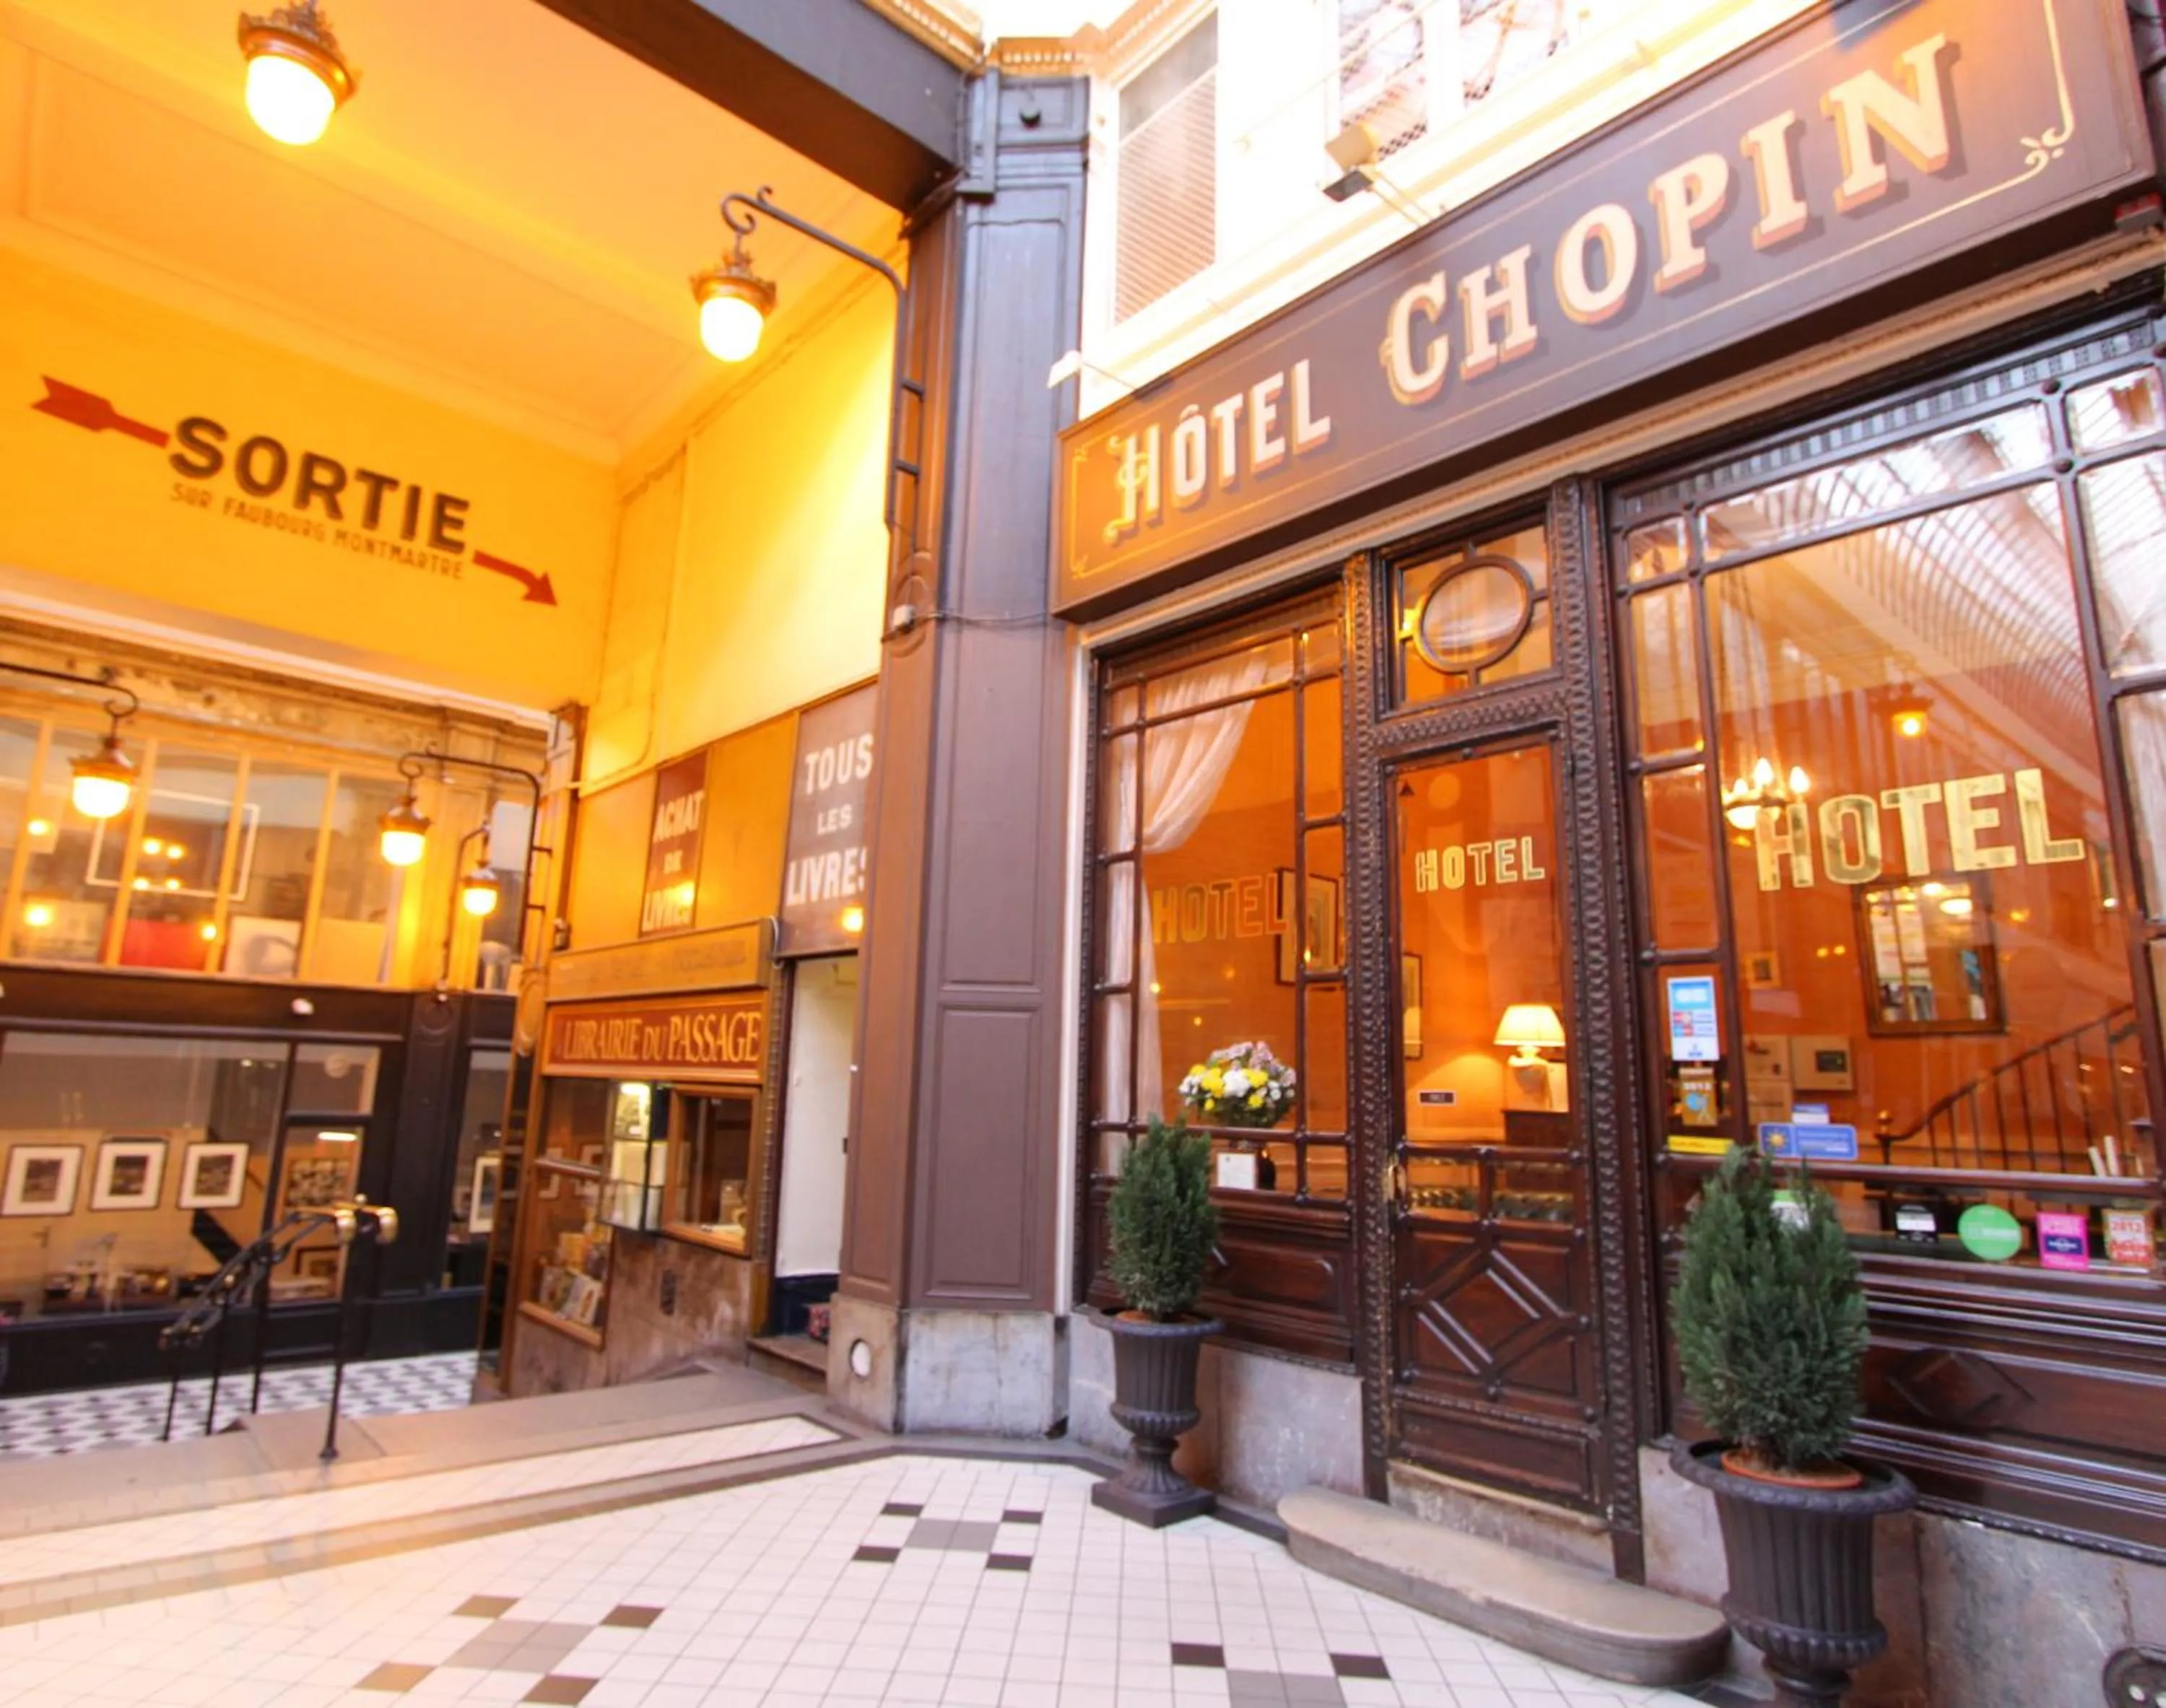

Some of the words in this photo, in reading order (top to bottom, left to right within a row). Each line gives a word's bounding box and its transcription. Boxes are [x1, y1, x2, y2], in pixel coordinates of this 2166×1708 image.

[1102, 358, 1331, 546] HÔTEL
[1380, 32, 1951, 407] CHOPIN
[169, 416, 471, 554] SORTIE
[170, 482, 213, 510] SUR
[222, 497, 326, 544] FAUBOURG
[331, 528, 465, 580] MONTMARTRE
[805, 733, 874, 796] TOUS
[653, 789, 705, 844] ACHAT
[816, 803, 853, 836] LES
[1753, 767, 2085, 892] HOTEL
[1415, 835, 1546, 893] HOTEL
[1151, 873, 1290, 946] HOTEL
[563, 1017, 643, 1060] LIBRAIRIE
[642, 1025, 668, 1061] DU
[667, 1011, 762, 1063] PASSAGE
